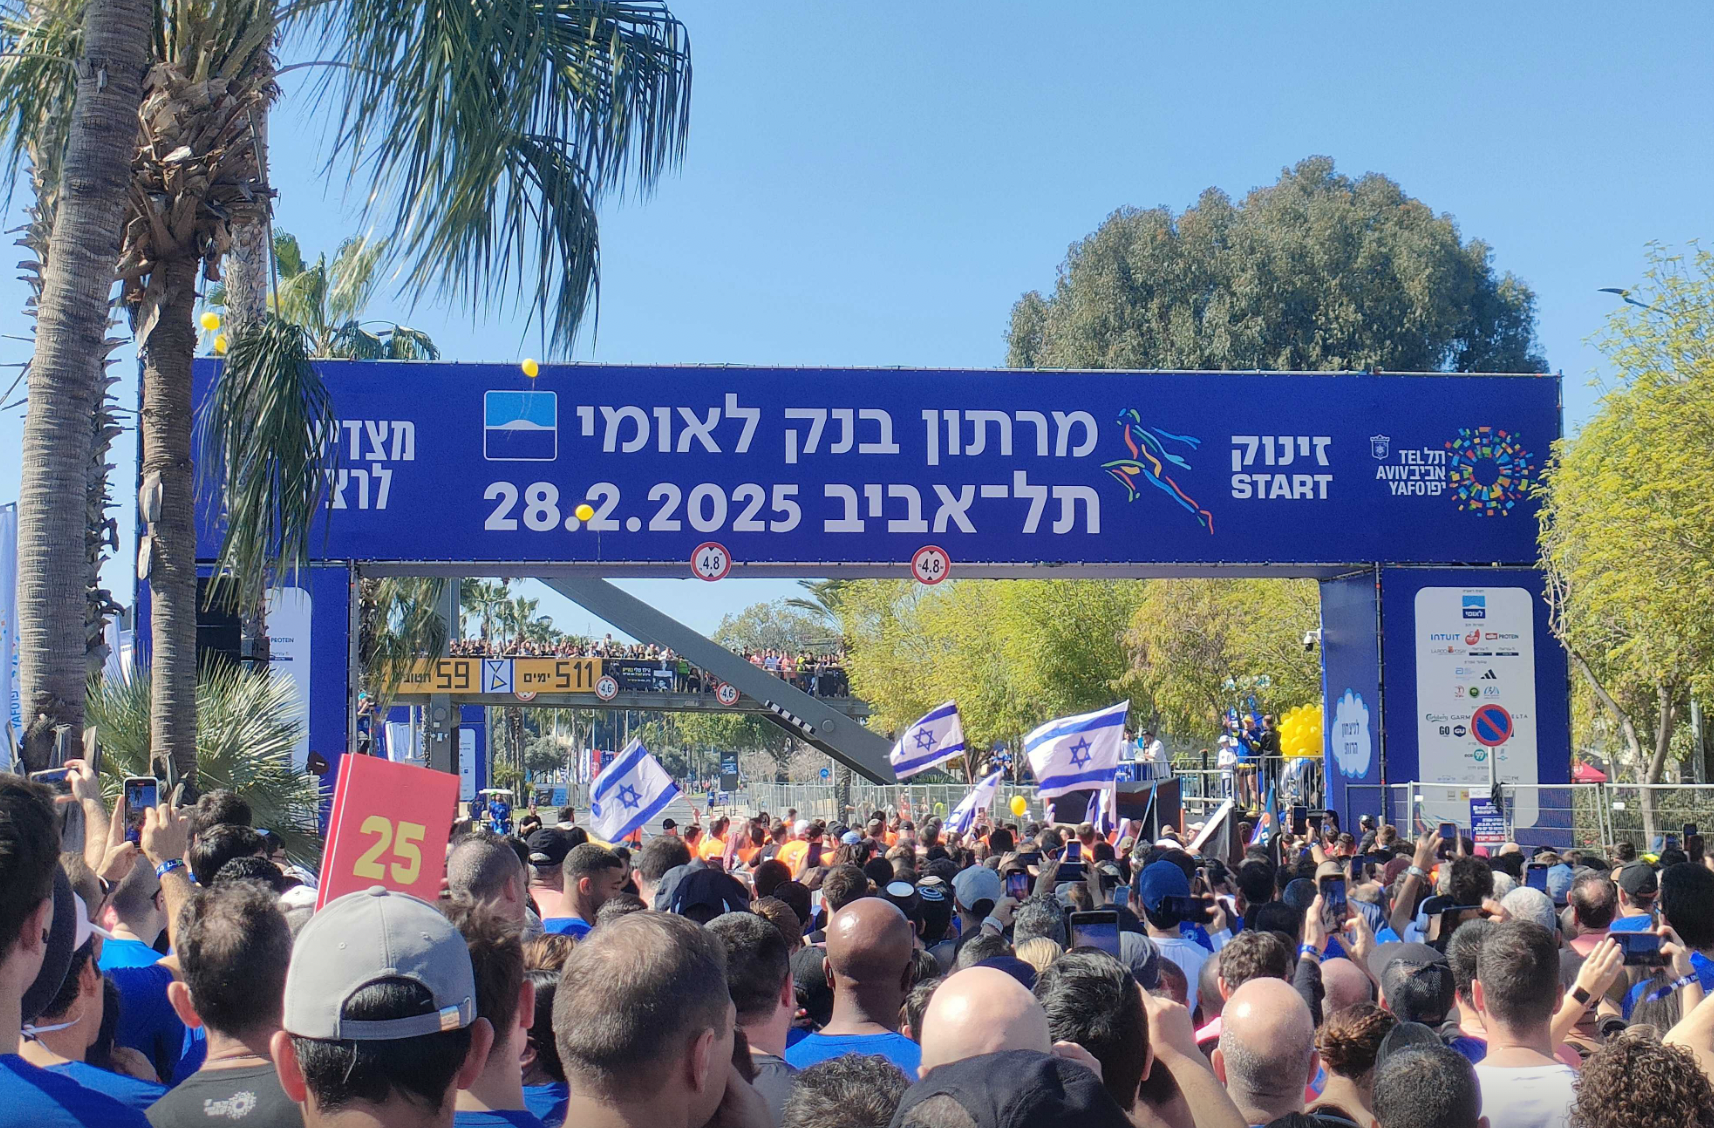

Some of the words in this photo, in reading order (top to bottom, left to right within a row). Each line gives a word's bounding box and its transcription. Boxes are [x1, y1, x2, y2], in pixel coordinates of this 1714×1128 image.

[577, 393, 761, 453] לאומי
[785, 408, 899, 464] בנק
[922, 409, 1098, 466] מרתון
[1231, 435, 1332, 471] זינוק
[1399, 450, 1425, 464] TEL
[1424, 446, 1446, 464] תל
[1375, 465, 1409, 480] AVIV
[1409, 465, 1446, 480] אביב
[1231, 473, 1333, 500] START
[1389, 481, 1425, 496] YAFO
[1425, 481, 1447, 496] יפו
[483, 482, 802, 532] 28.2.2025
[702, 555, 720, 570] 4.8
[921, 558, 940, 573] 4.8
[436, 661, 470, 689] 59
[523, 673, 550, 683] ימים
[555, 661, 593, 688] 511
[599, 683, 613, 693] 4.6
[722, 688, 734, 698] 4.6
[353, 815, 426, 885] 25
